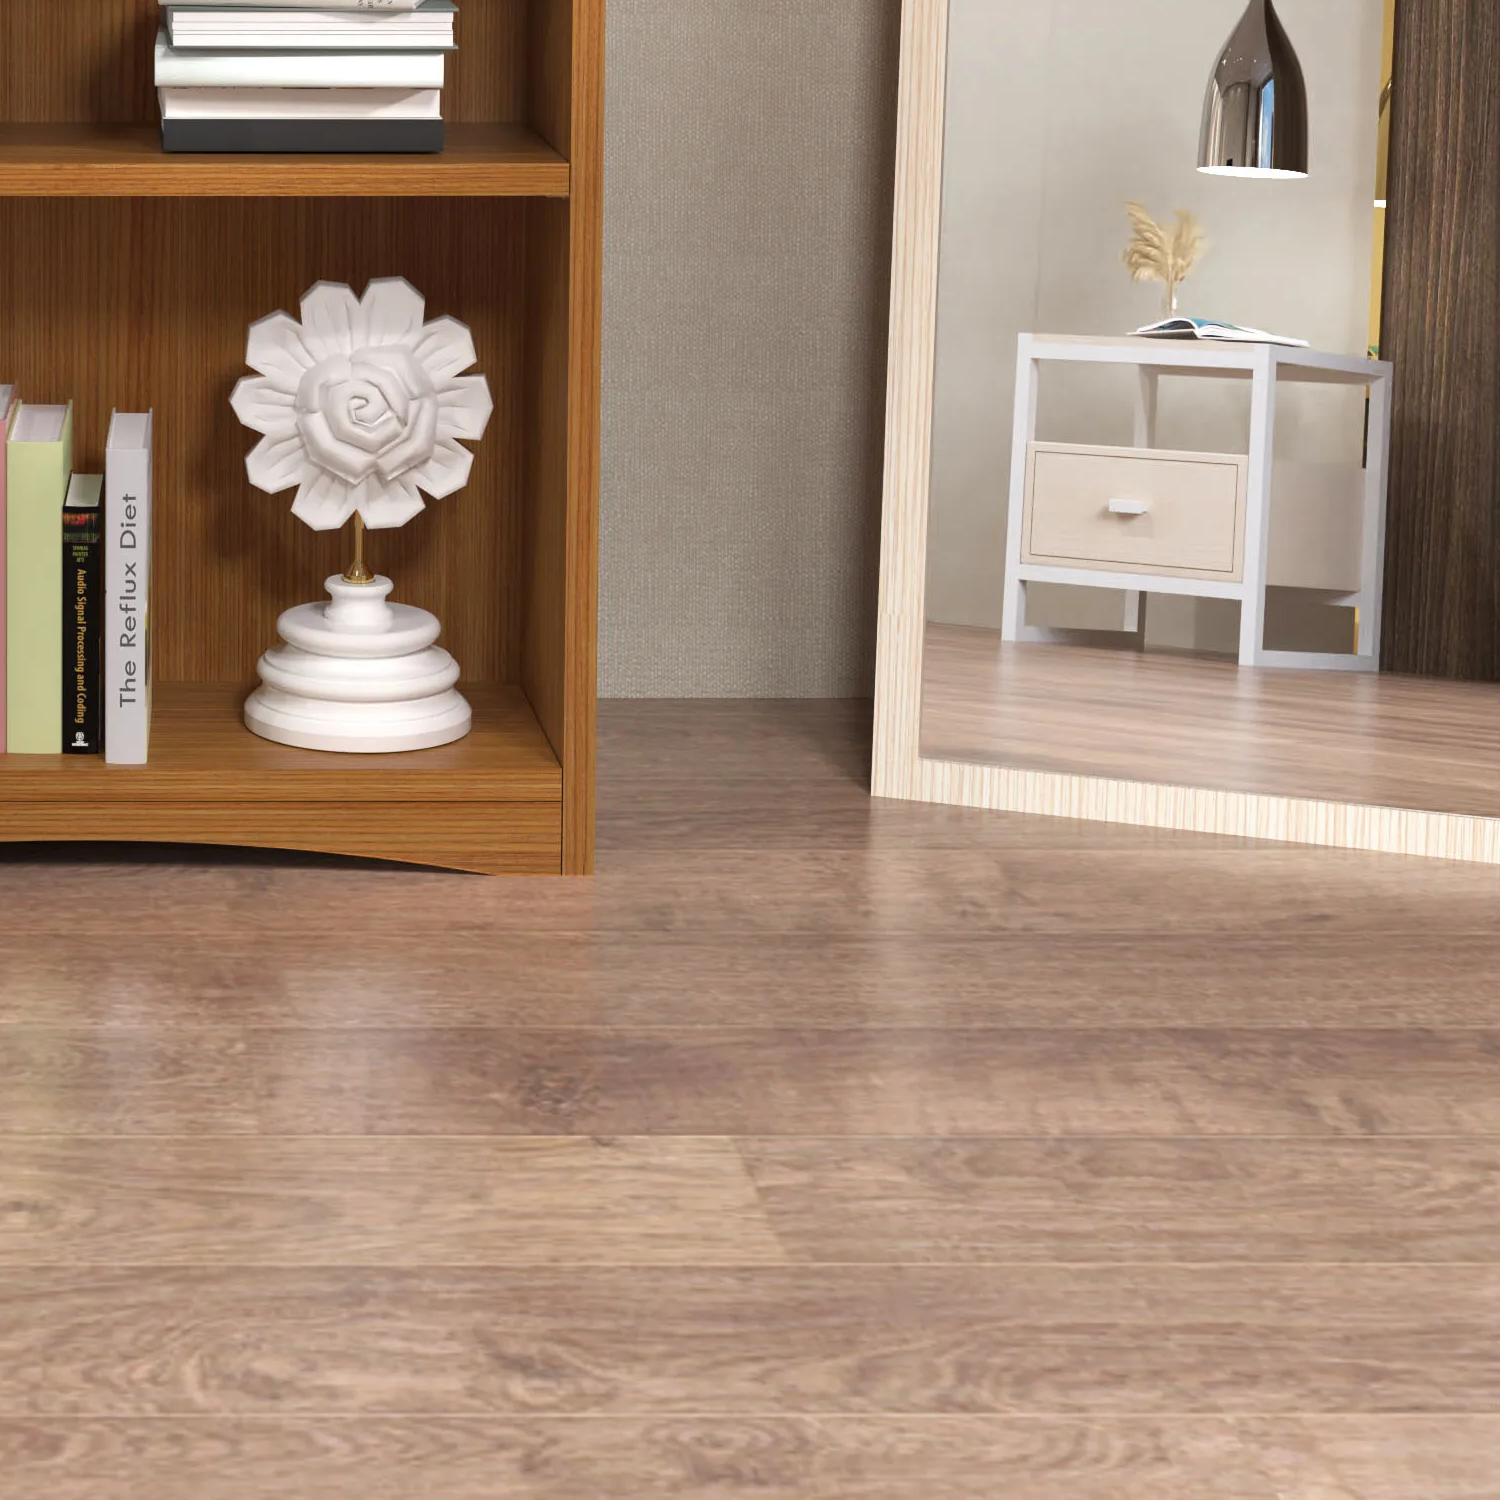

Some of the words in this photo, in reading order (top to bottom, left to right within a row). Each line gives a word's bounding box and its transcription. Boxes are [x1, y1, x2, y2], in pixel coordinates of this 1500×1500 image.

[118, 493, 137, 549] Diet
[76, 568, 87, 594] Audio
[74, 596, 87, 624] Signal
[118, 561, 137, 648] Reflux
[74, 626, 87, 672] Processing
[76, 674, 87, 691] and
[118, 659, 137, 709] The
[75, 692, 87, 724] Coding
